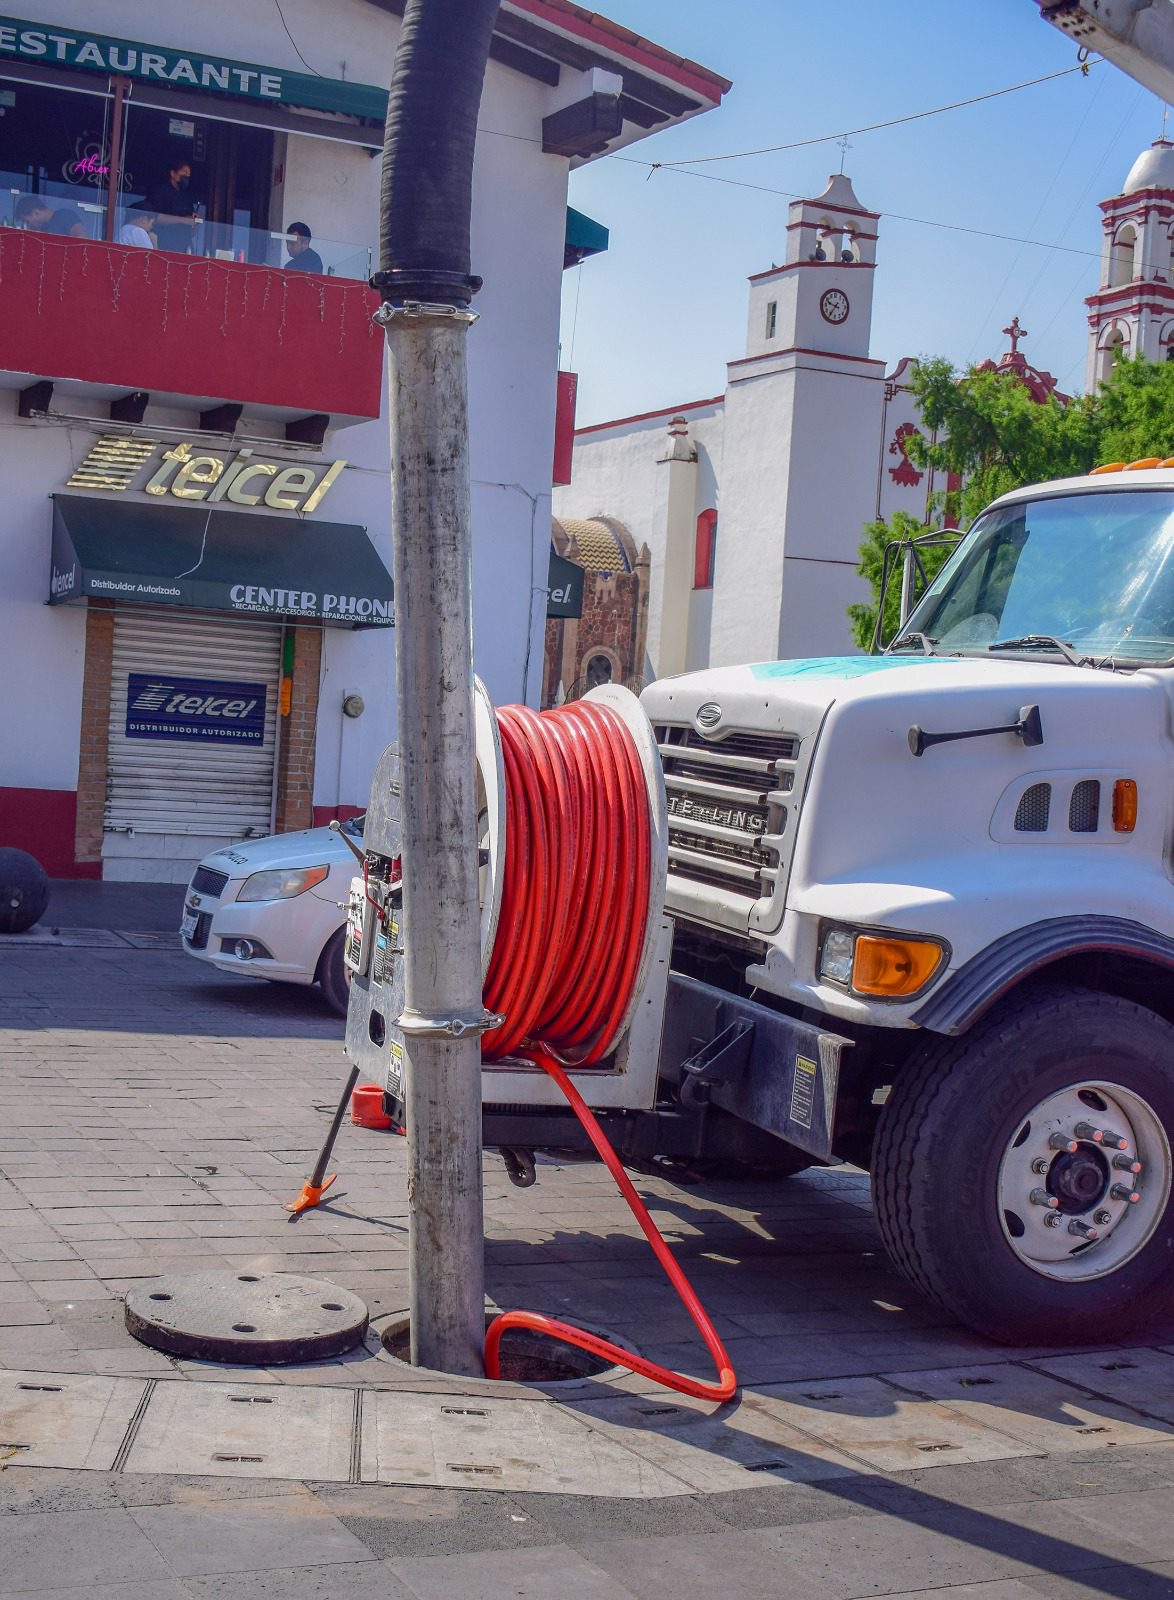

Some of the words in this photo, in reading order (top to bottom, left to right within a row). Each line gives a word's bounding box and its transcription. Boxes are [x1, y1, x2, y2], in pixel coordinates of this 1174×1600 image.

[145, 442, 349, 513] telcel
[91, 579, 136, 592] Distribuidor
[137, 584, 181, 597] Autorizado
[229, 584, 317, 609] CENTER
[275, 607, 316, 617] ACCESORIOS
[321, 611, 367, 623] REPARACIONES
[165, 692, 258, 719] telcel
[129, 723, 199, 734] DISTRIBUIDOR
[201, 728, 261, 739] AUTORIZADO
[668, 797, 763, 829] TELING
